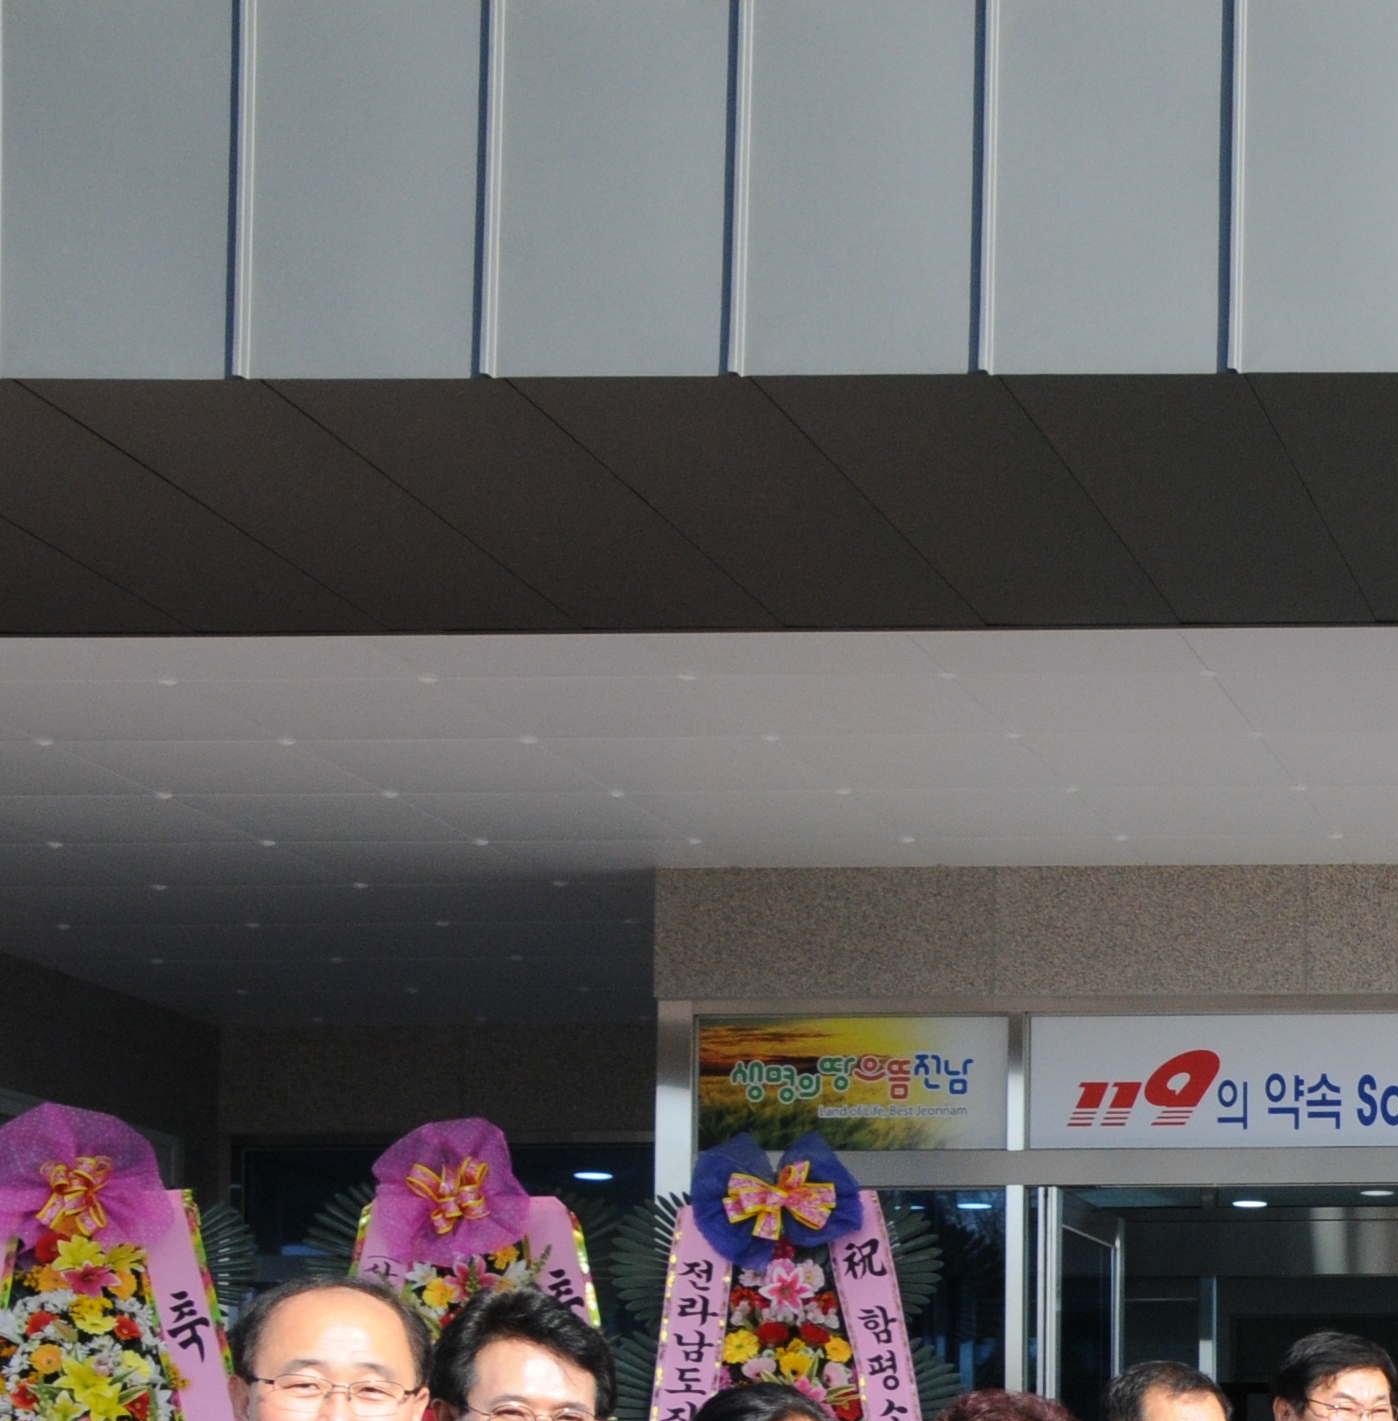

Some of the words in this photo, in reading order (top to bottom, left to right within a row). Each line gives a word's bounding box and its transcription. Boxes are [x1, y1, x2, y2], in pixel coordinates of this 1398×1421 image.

[819, 1105, 849, 1117] Land
[889, 1105, 913, 1117] Best
[1265, 1073, 1342, 1130] 약속
[843, 1238, 887, 1280] 祝
[167, 1290, 210, 1363] 축
